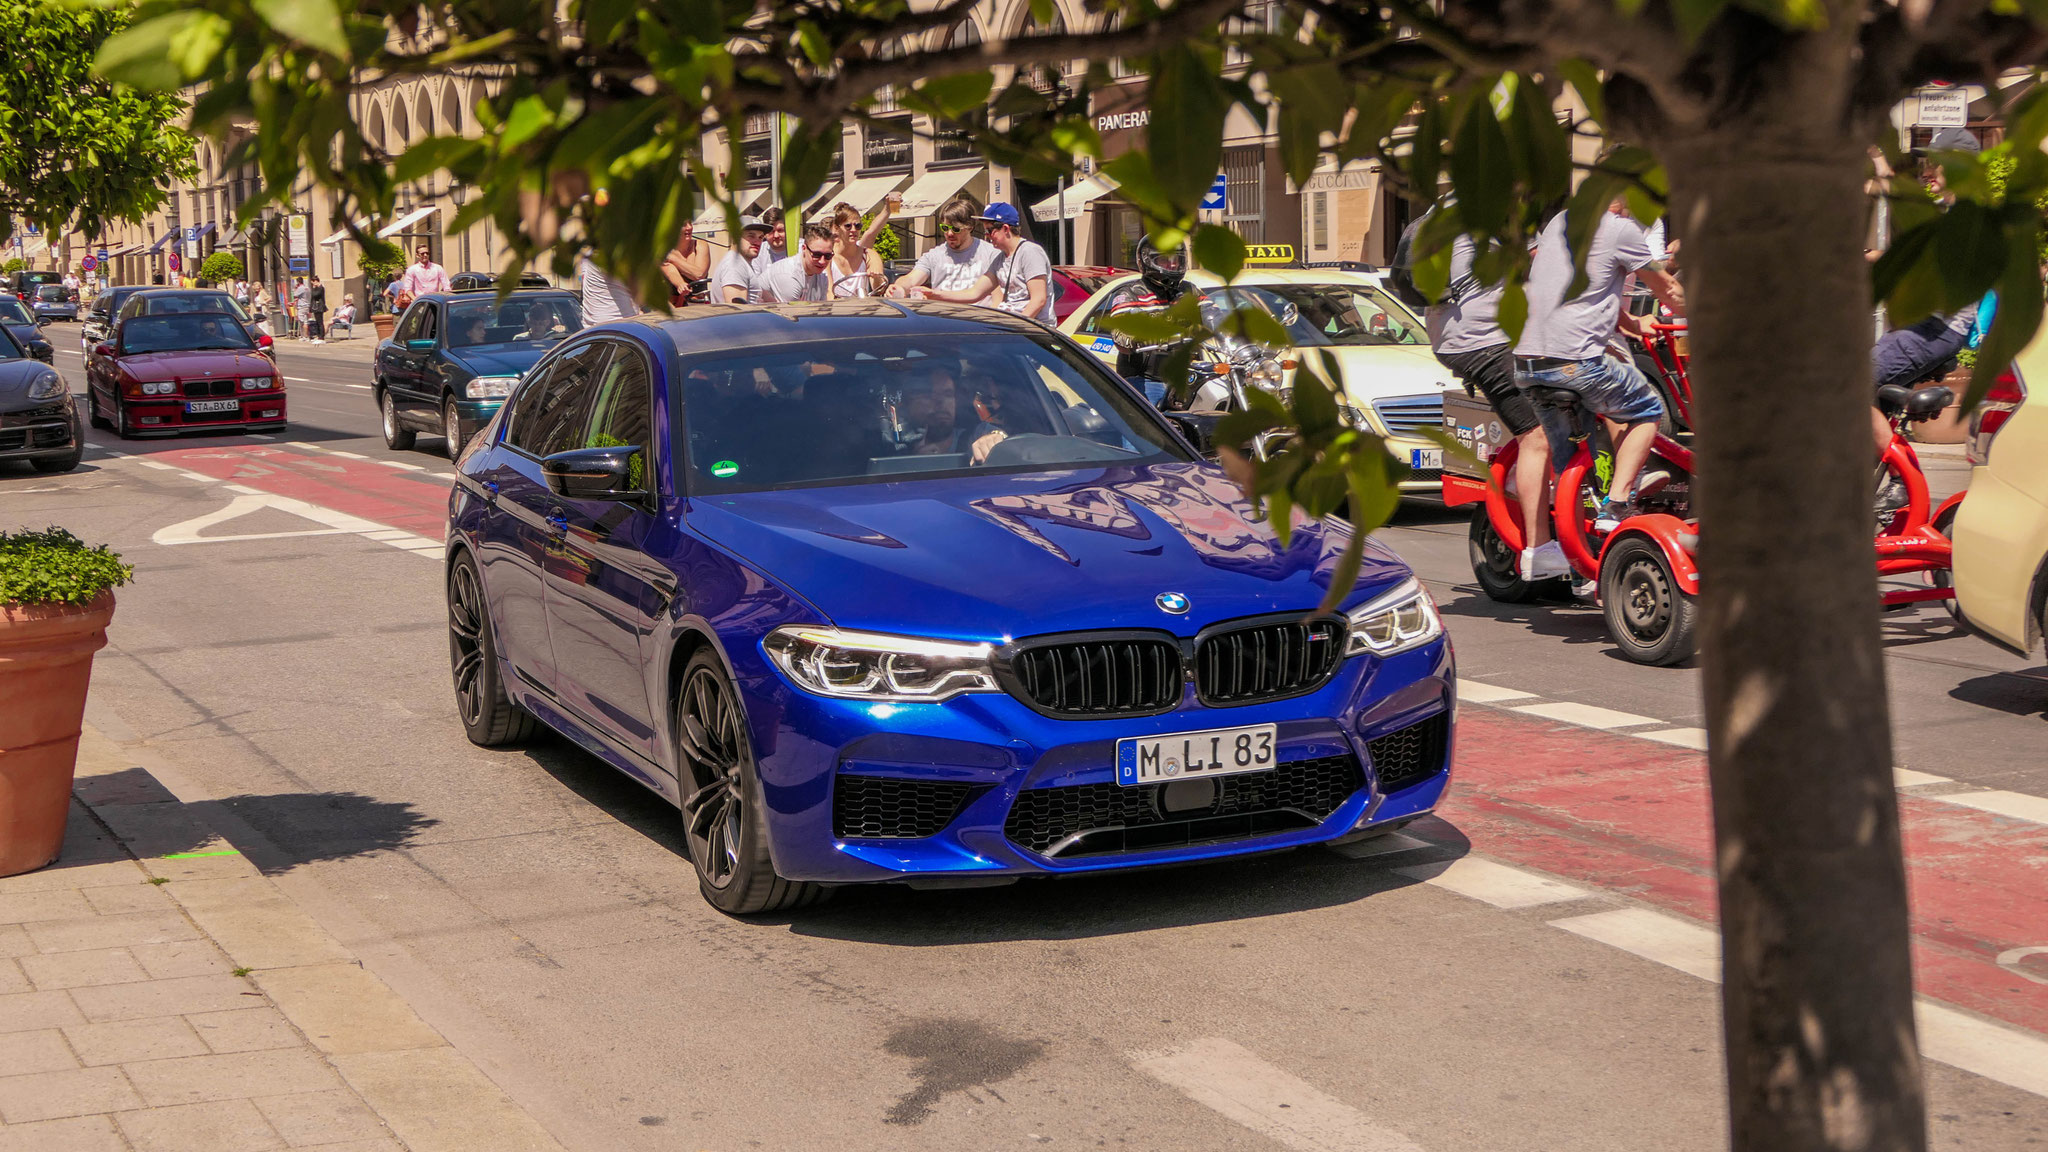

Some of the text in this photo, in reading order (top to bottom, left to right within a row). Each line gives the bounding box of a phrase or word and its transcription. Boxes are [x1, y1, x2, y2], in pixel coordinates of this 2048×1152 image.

[1308, 175, 1348, 189] GUCCI
[1246, 247, 1286, 257] TAXI
[191, 401, 238, 412] STA BX 61
[1457, 428, 1472, 439] FCK
[1422, 452, 1431, 466] M
[1184, 737, 1223, 772] LI
[1234, 731, 1272, 767] 83
